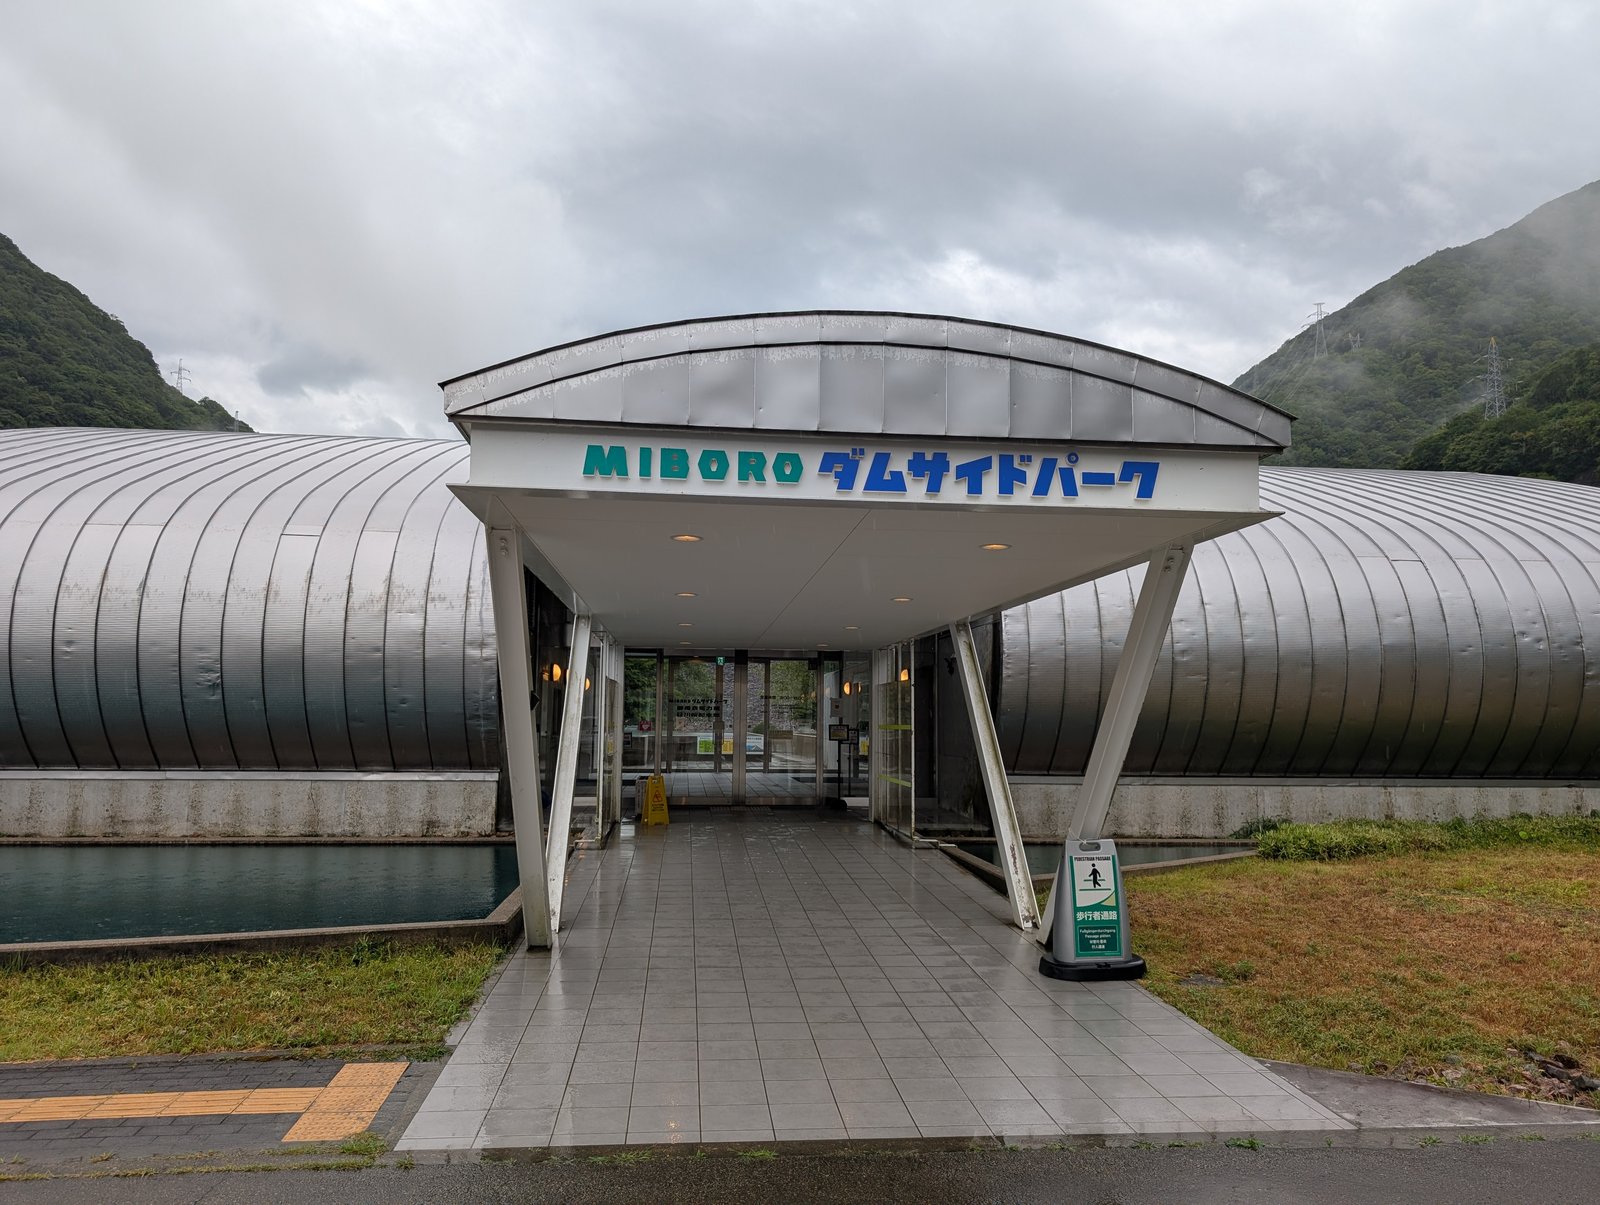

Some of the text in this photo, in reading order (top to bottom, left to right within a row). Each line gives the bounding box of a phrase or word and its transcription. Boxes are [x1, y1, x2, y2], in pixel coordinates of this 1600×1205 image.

[582, 444, 1160, 499] MIBORO ダムサイドパーク
[1077, 911, 1117, 921] 歩行者通路
